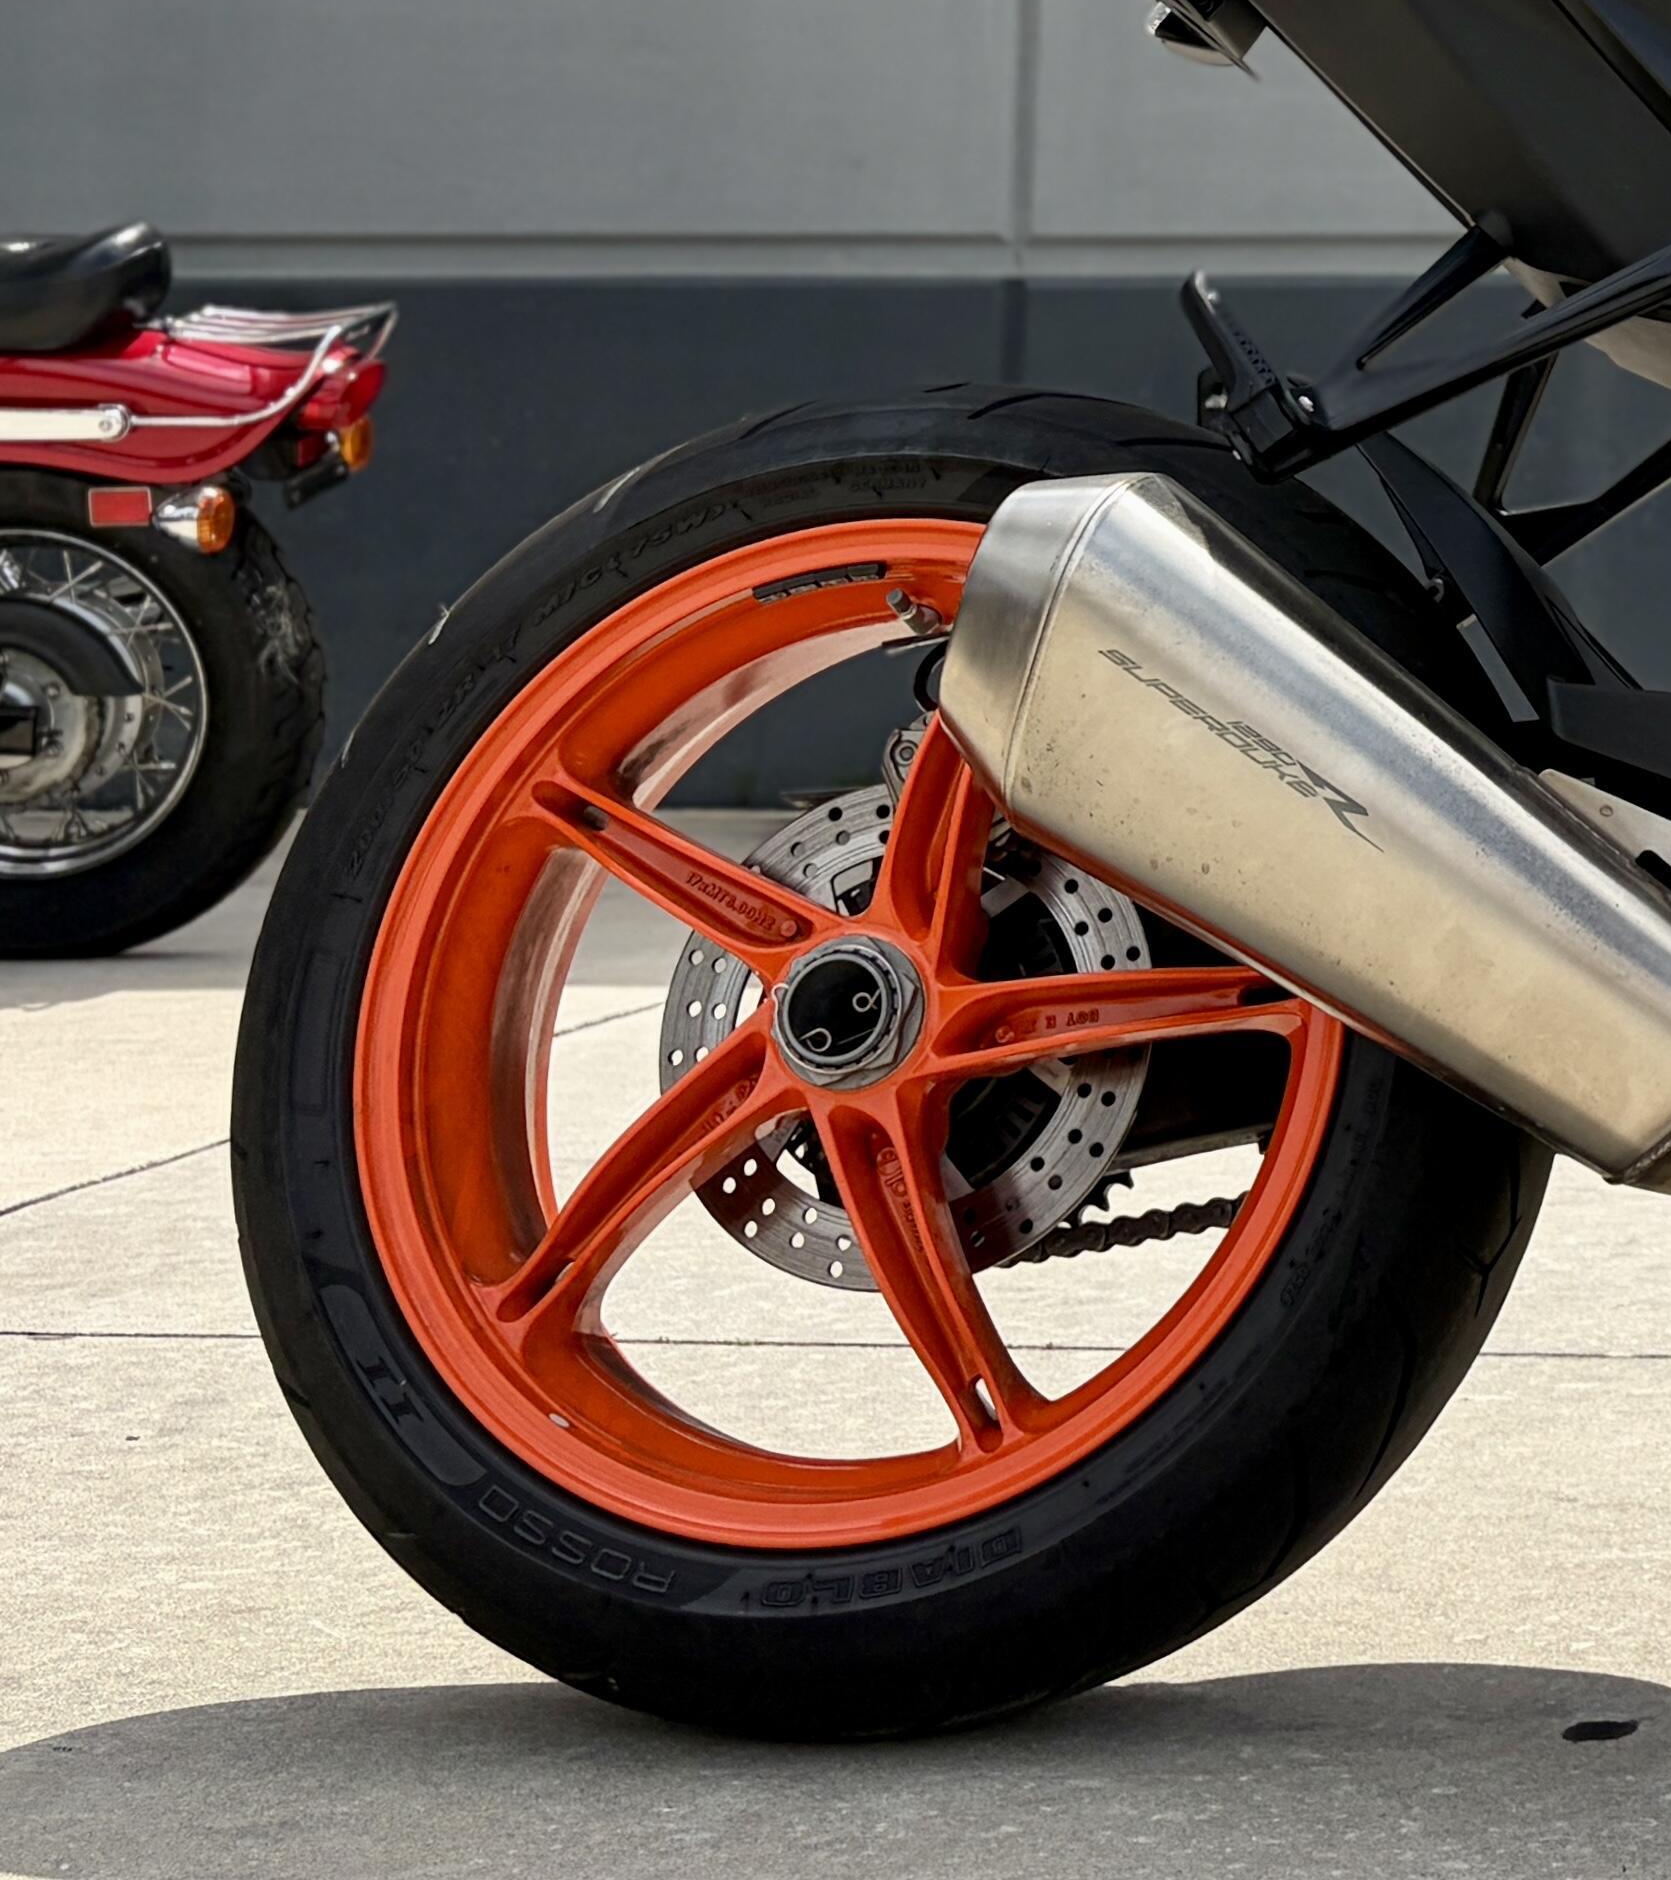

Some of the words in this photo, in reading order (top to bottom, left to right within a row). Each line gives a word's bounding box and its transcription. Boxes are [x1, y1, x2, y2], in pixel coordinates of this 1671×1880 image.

[1227, 720, 1297, 767] 1290
[478, 1482, 678, 1595] ROSSO
[761, 1527, 1023, 1608] DIABLO
